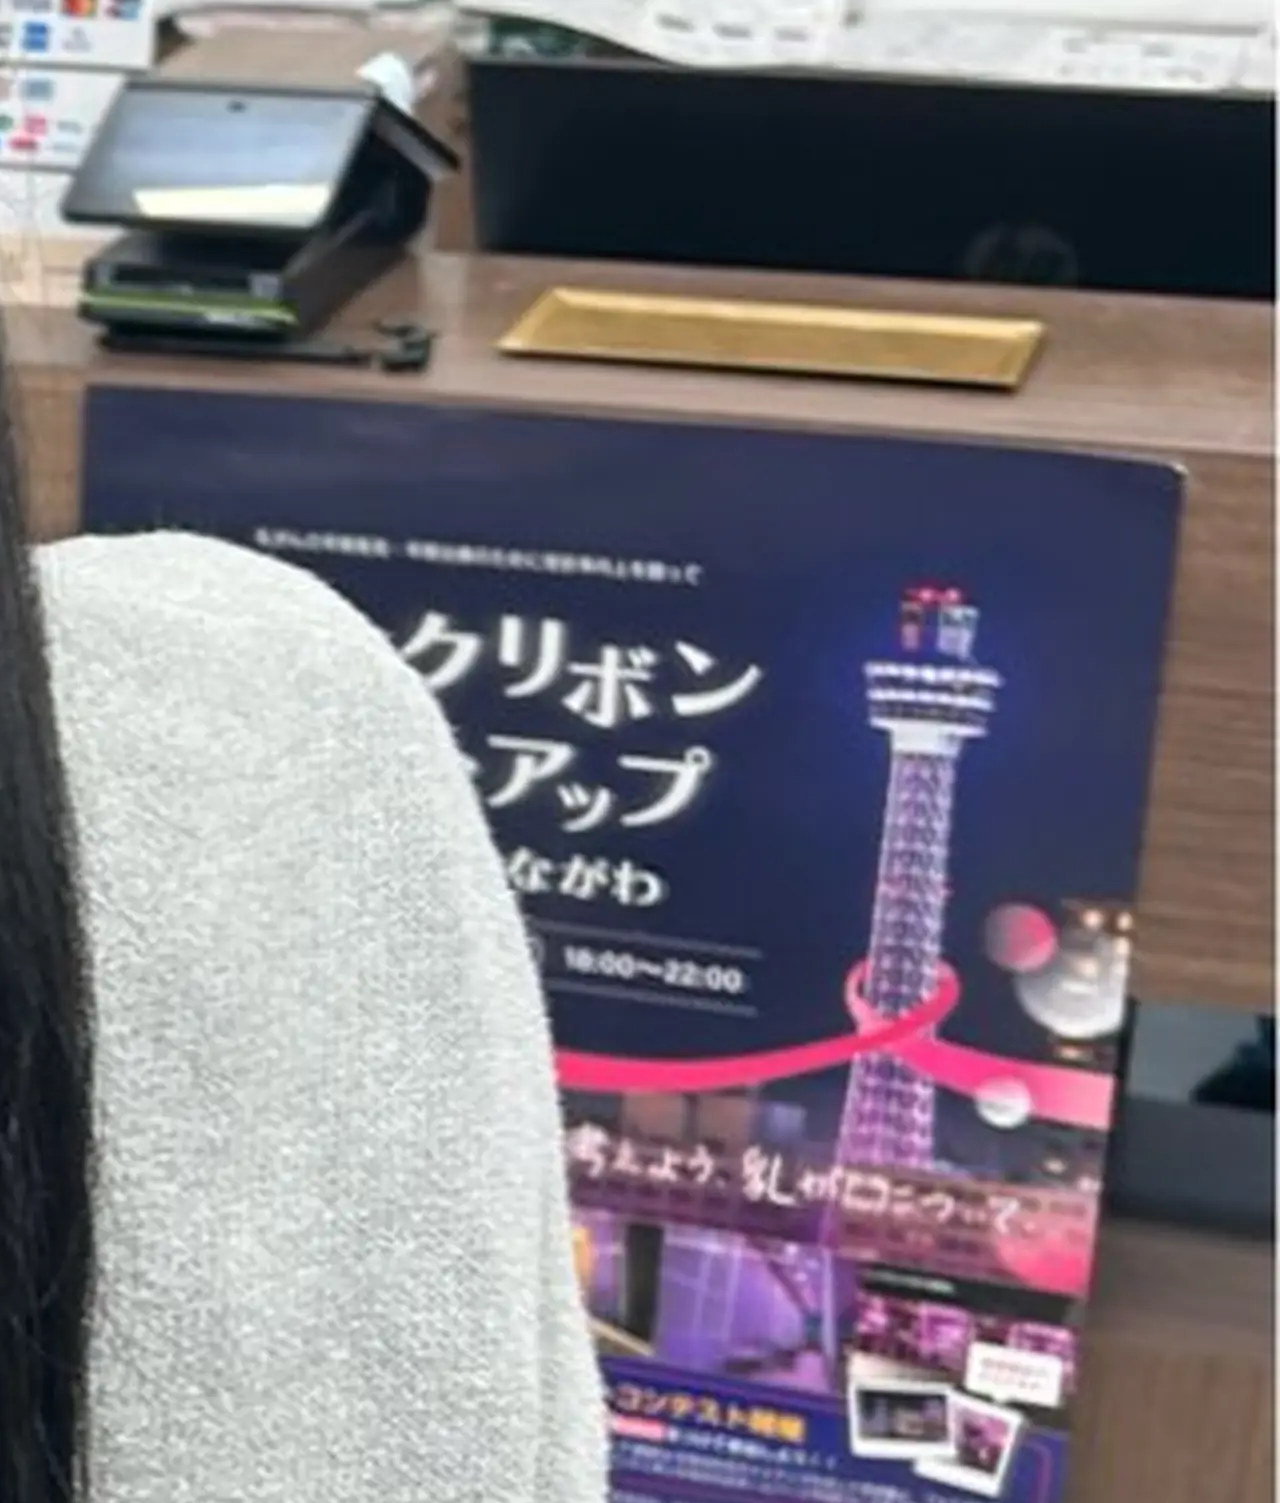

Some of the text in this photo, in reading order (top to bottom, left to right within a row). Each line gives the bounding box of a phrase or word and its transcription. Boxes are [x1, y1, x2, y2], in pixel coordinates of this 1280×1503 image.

[399, 610, 763, 728] クリボン
[460, 732, 715, 833] アップ
[508, 846, 670, 907] ながわ
